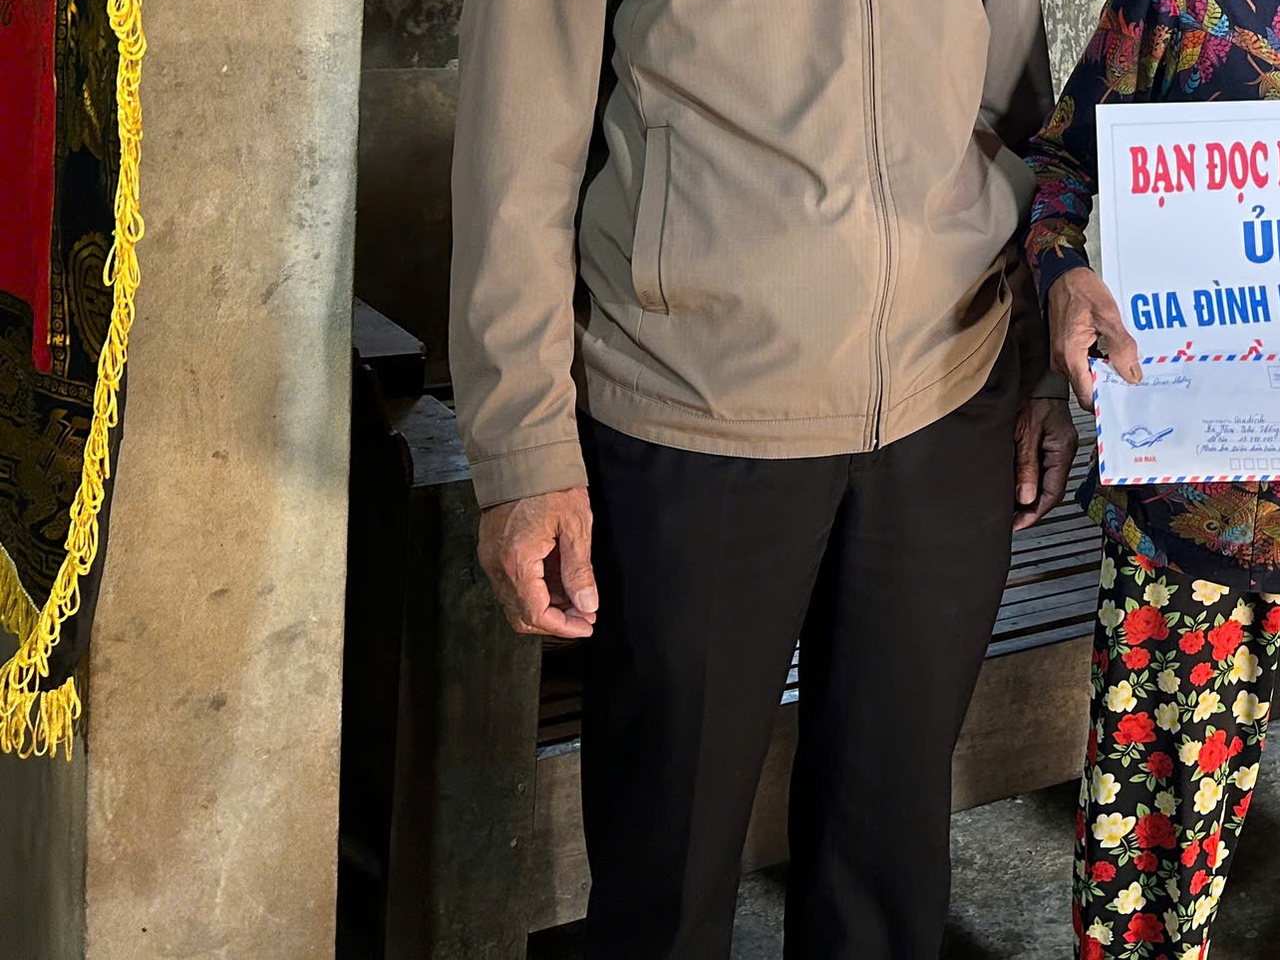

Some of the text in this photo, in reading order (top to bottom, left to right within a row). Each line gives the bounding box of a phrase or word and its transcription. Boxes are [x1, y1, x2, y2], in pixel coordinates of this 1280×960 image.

[1129, 143, 1196, 208] BẠN
[1205, 140, 1269, 204] ĐỌC
[1130, 291, 1188, 331] GIA
[1193, 279, 1272, 327] ĐÌNH
